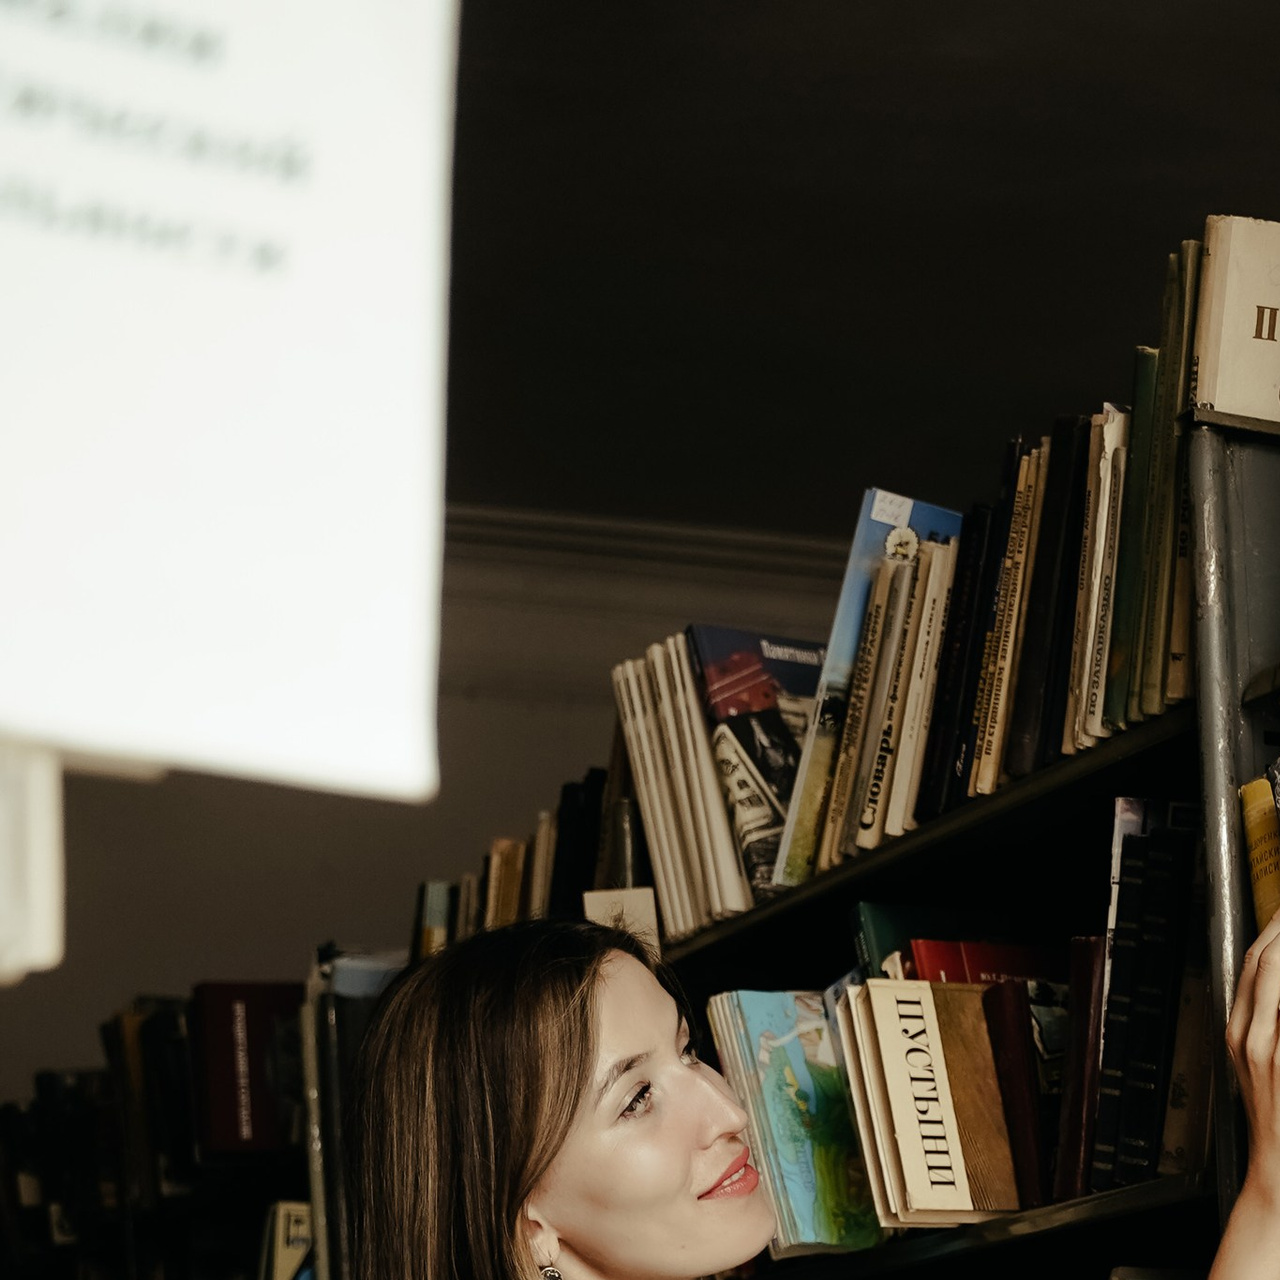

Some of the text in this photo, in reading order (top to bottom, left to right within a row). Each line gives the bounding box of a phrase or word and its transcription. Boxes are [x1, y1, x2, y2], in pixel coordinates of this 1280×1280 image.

[1087, 574, 1112, 715] ПО ЗАКАВКАЗЬЮ
[892, 991, 959, 1195] ПУСТЫНИ
